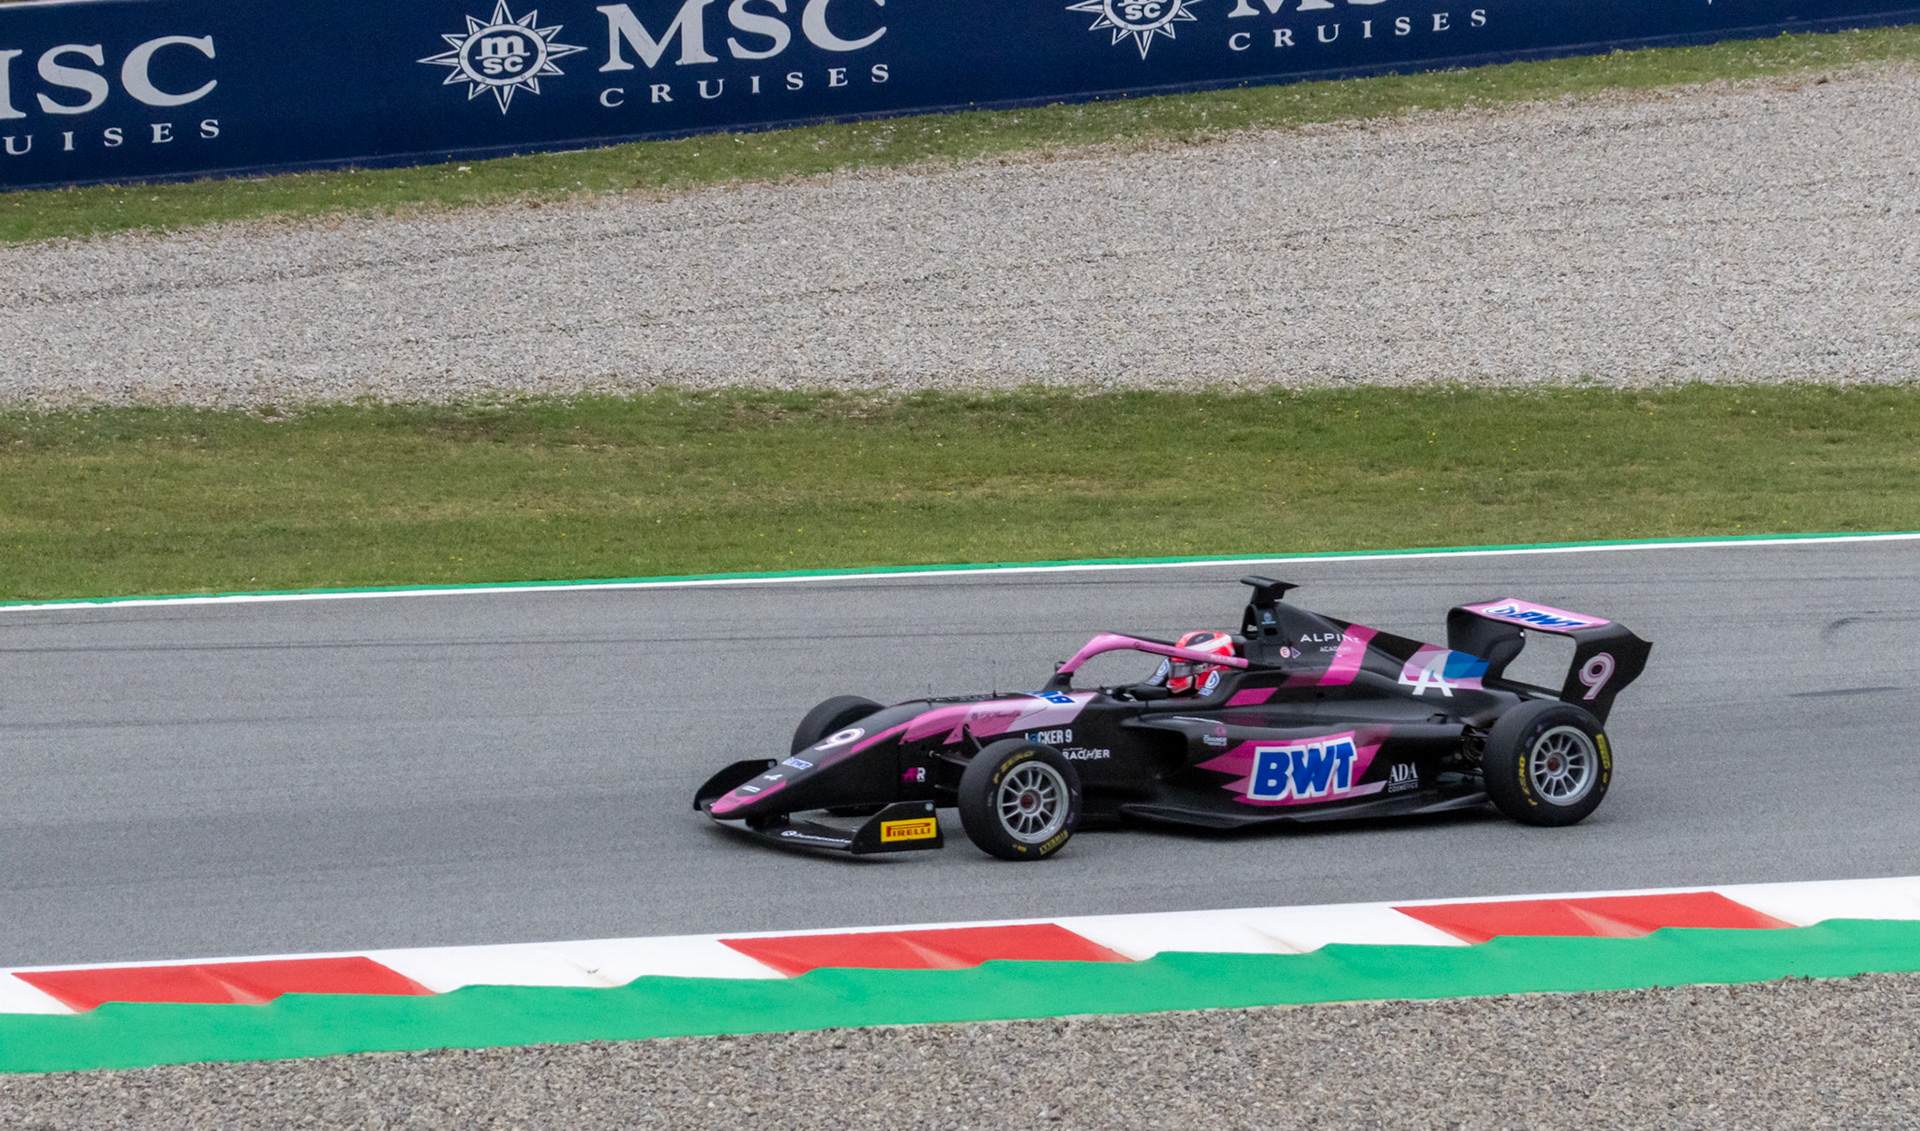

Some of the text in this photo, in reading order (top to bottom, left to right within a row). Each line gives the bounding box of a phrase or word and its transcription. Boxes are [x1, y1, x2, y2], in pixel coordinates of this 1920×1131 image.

[596, 0, 888, 72] MSC
[1228, 9, 1487, 51] CRUISES
[599, 63, 889, 108] CRUISES
[2, 119, 220, 155] UISES
[1579, 652, 1615, 700] 9
[814, 727, 866, 751] 9
[1065, 729, 1073, 743] 9
[1248, 737, 1357, 800] BWT
[1388, 762, 1419, 784] ADA
[886, 822, 932, 838] PIRELLI
